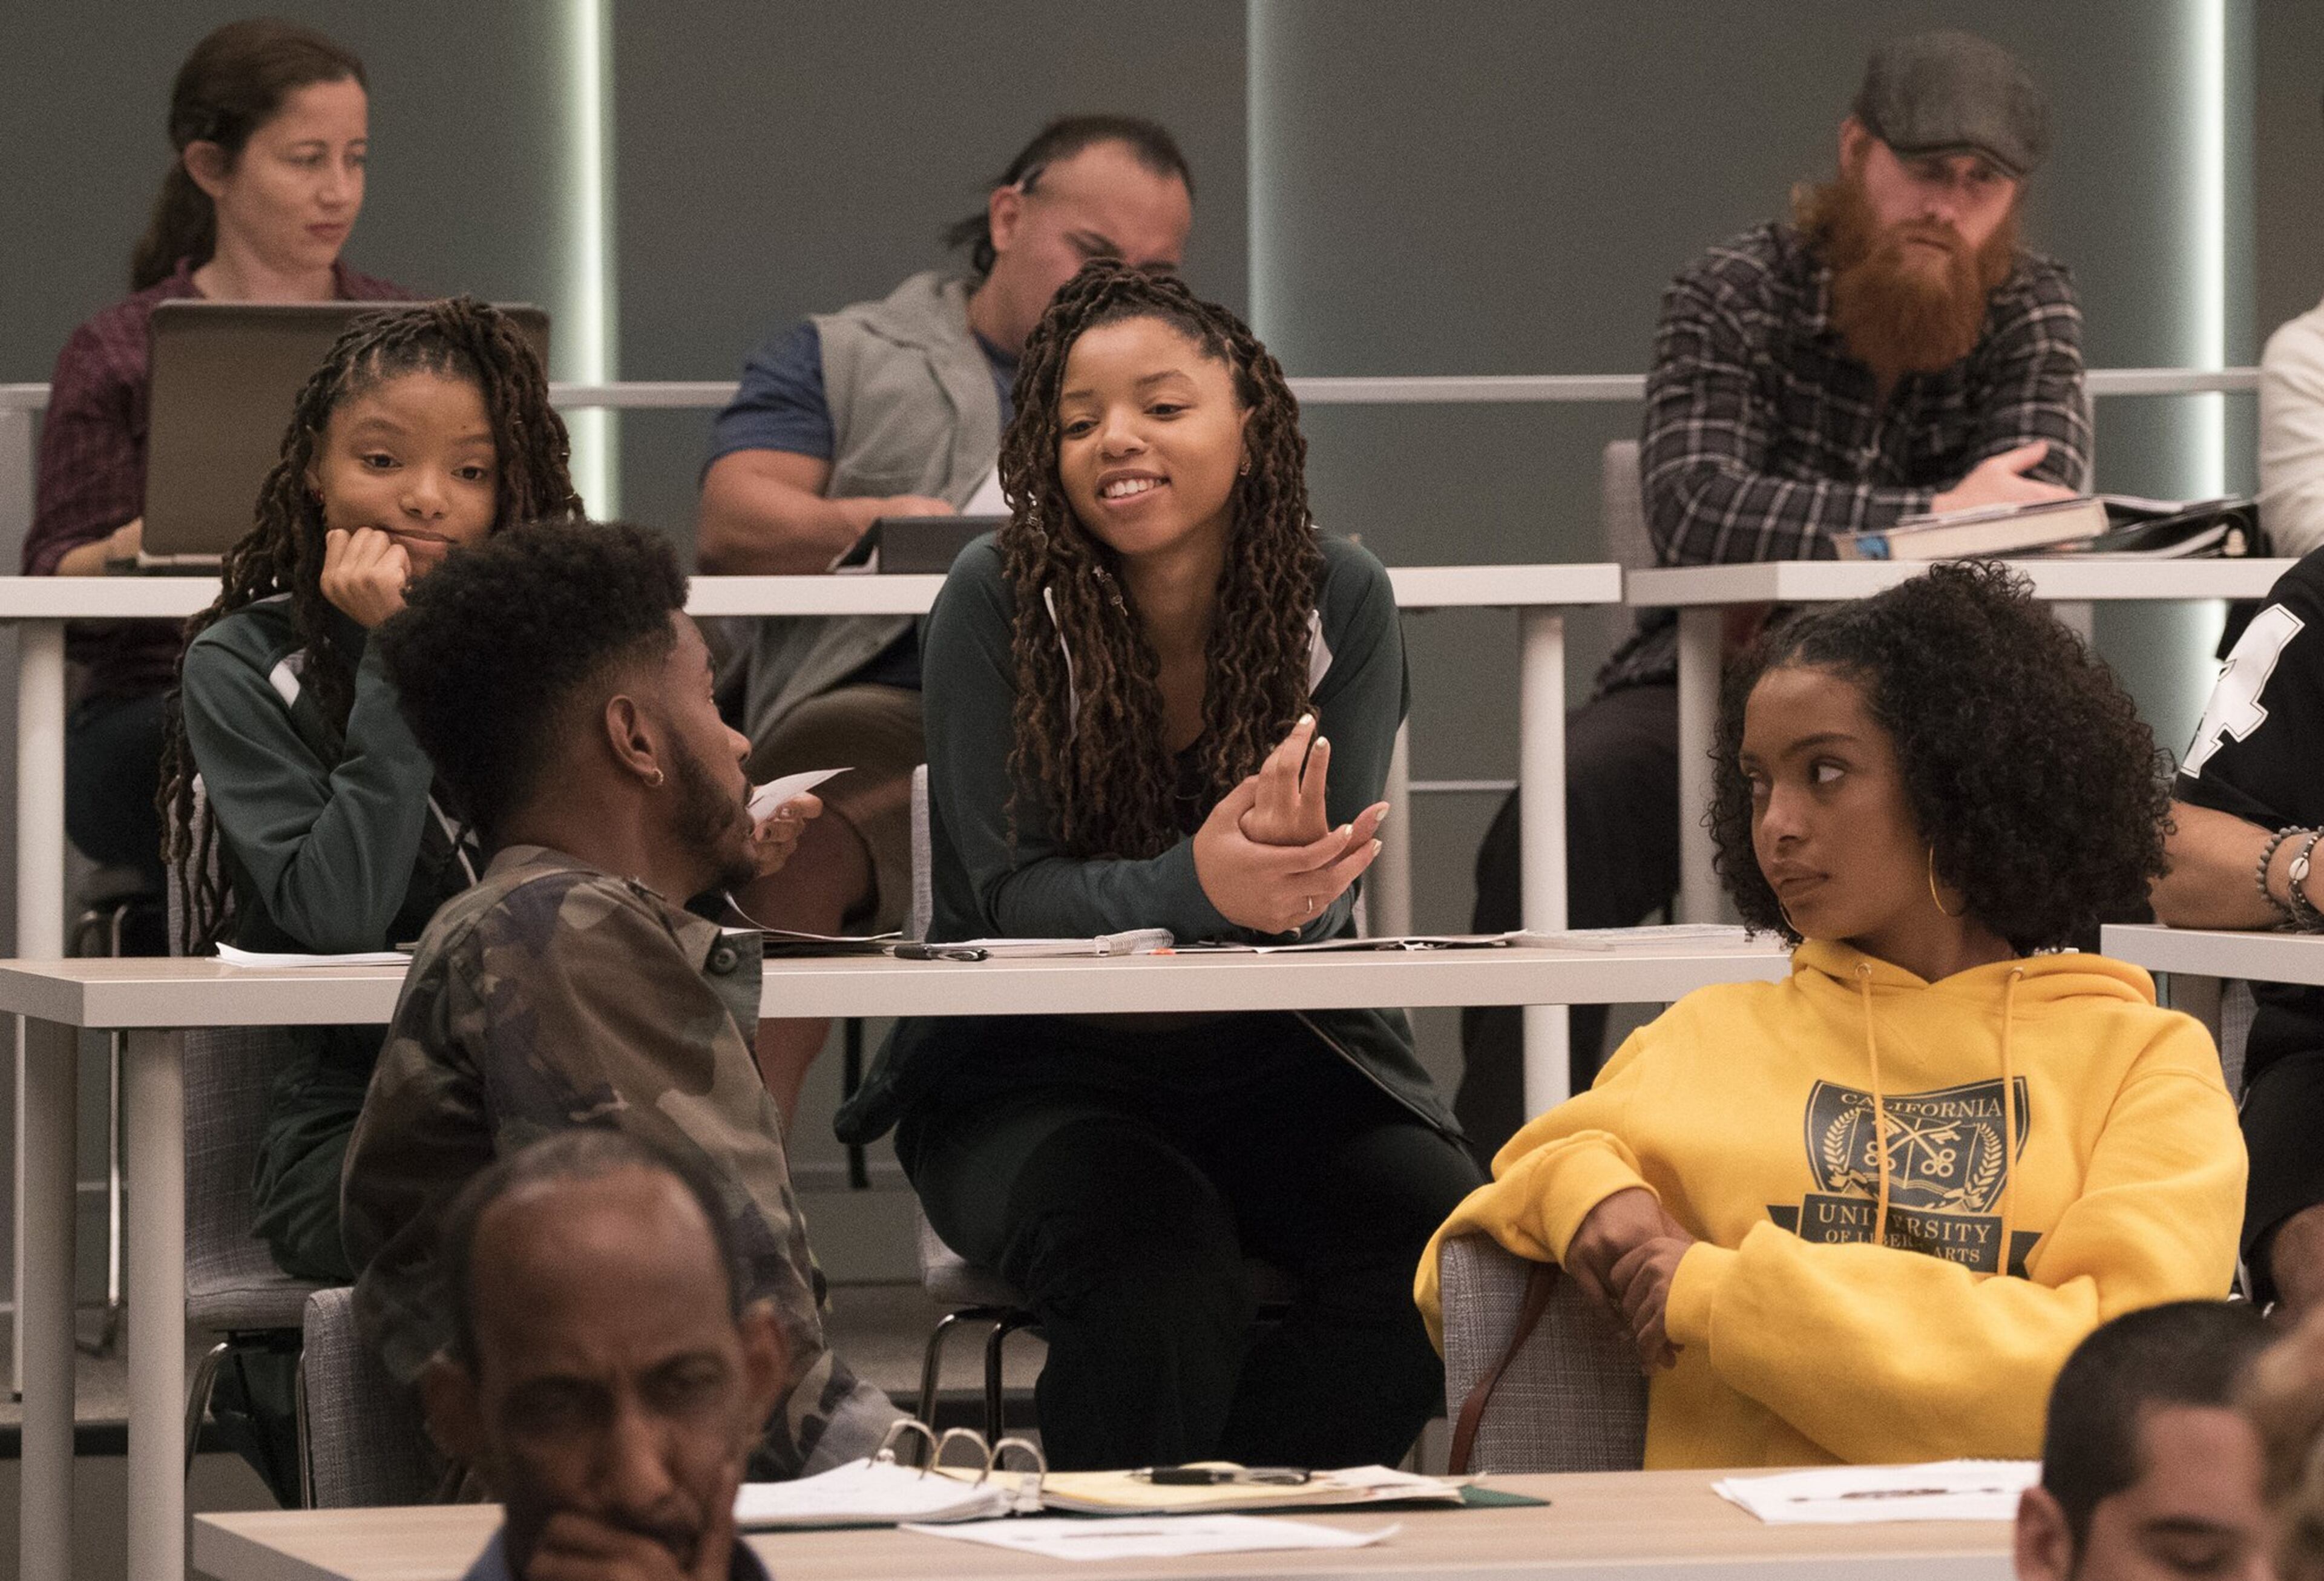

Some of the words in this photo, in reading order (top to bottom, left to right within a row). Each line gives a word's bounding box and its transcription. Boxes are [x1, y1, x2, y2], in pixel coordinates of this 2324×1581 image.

[1841, 1093, 2002, 1117] CAIFORNIA
[1817, 1203, 1991, 1243] UNIRSITY
[1825, 1229, 1851, 1243] OF
[1934, 1246, 1980, 1263] ARTS
